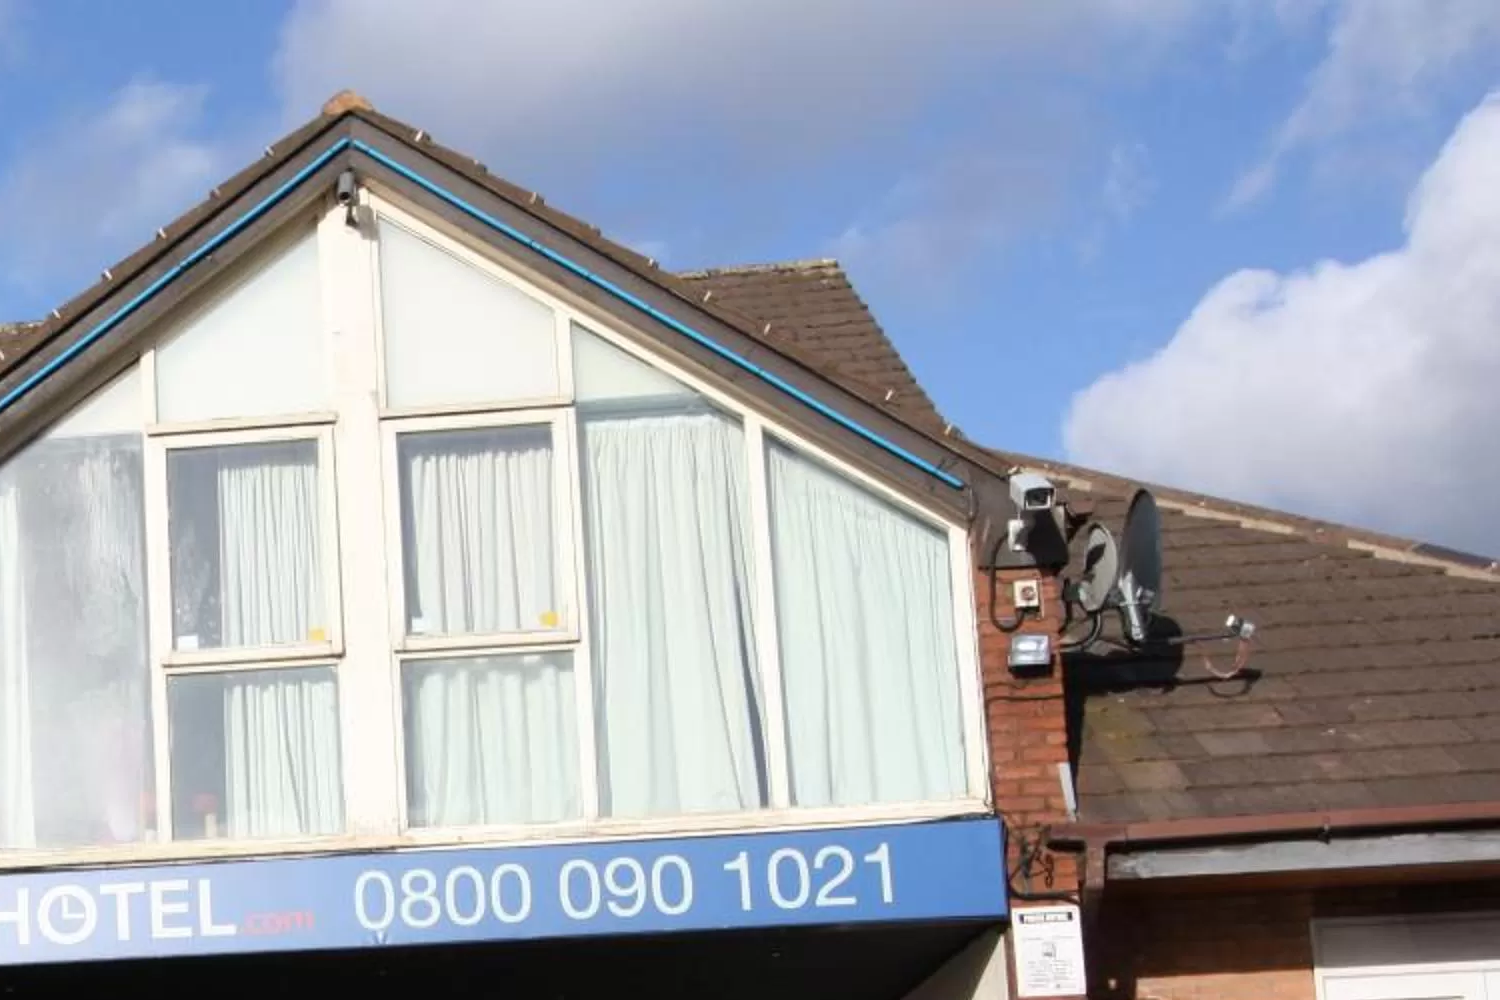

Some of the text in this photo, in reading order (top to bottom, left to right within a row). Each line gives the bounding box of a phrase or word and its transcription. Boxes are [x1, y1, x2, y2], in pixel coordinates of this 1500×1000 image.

[354, 842, 894, 931] 0800 090 1021
